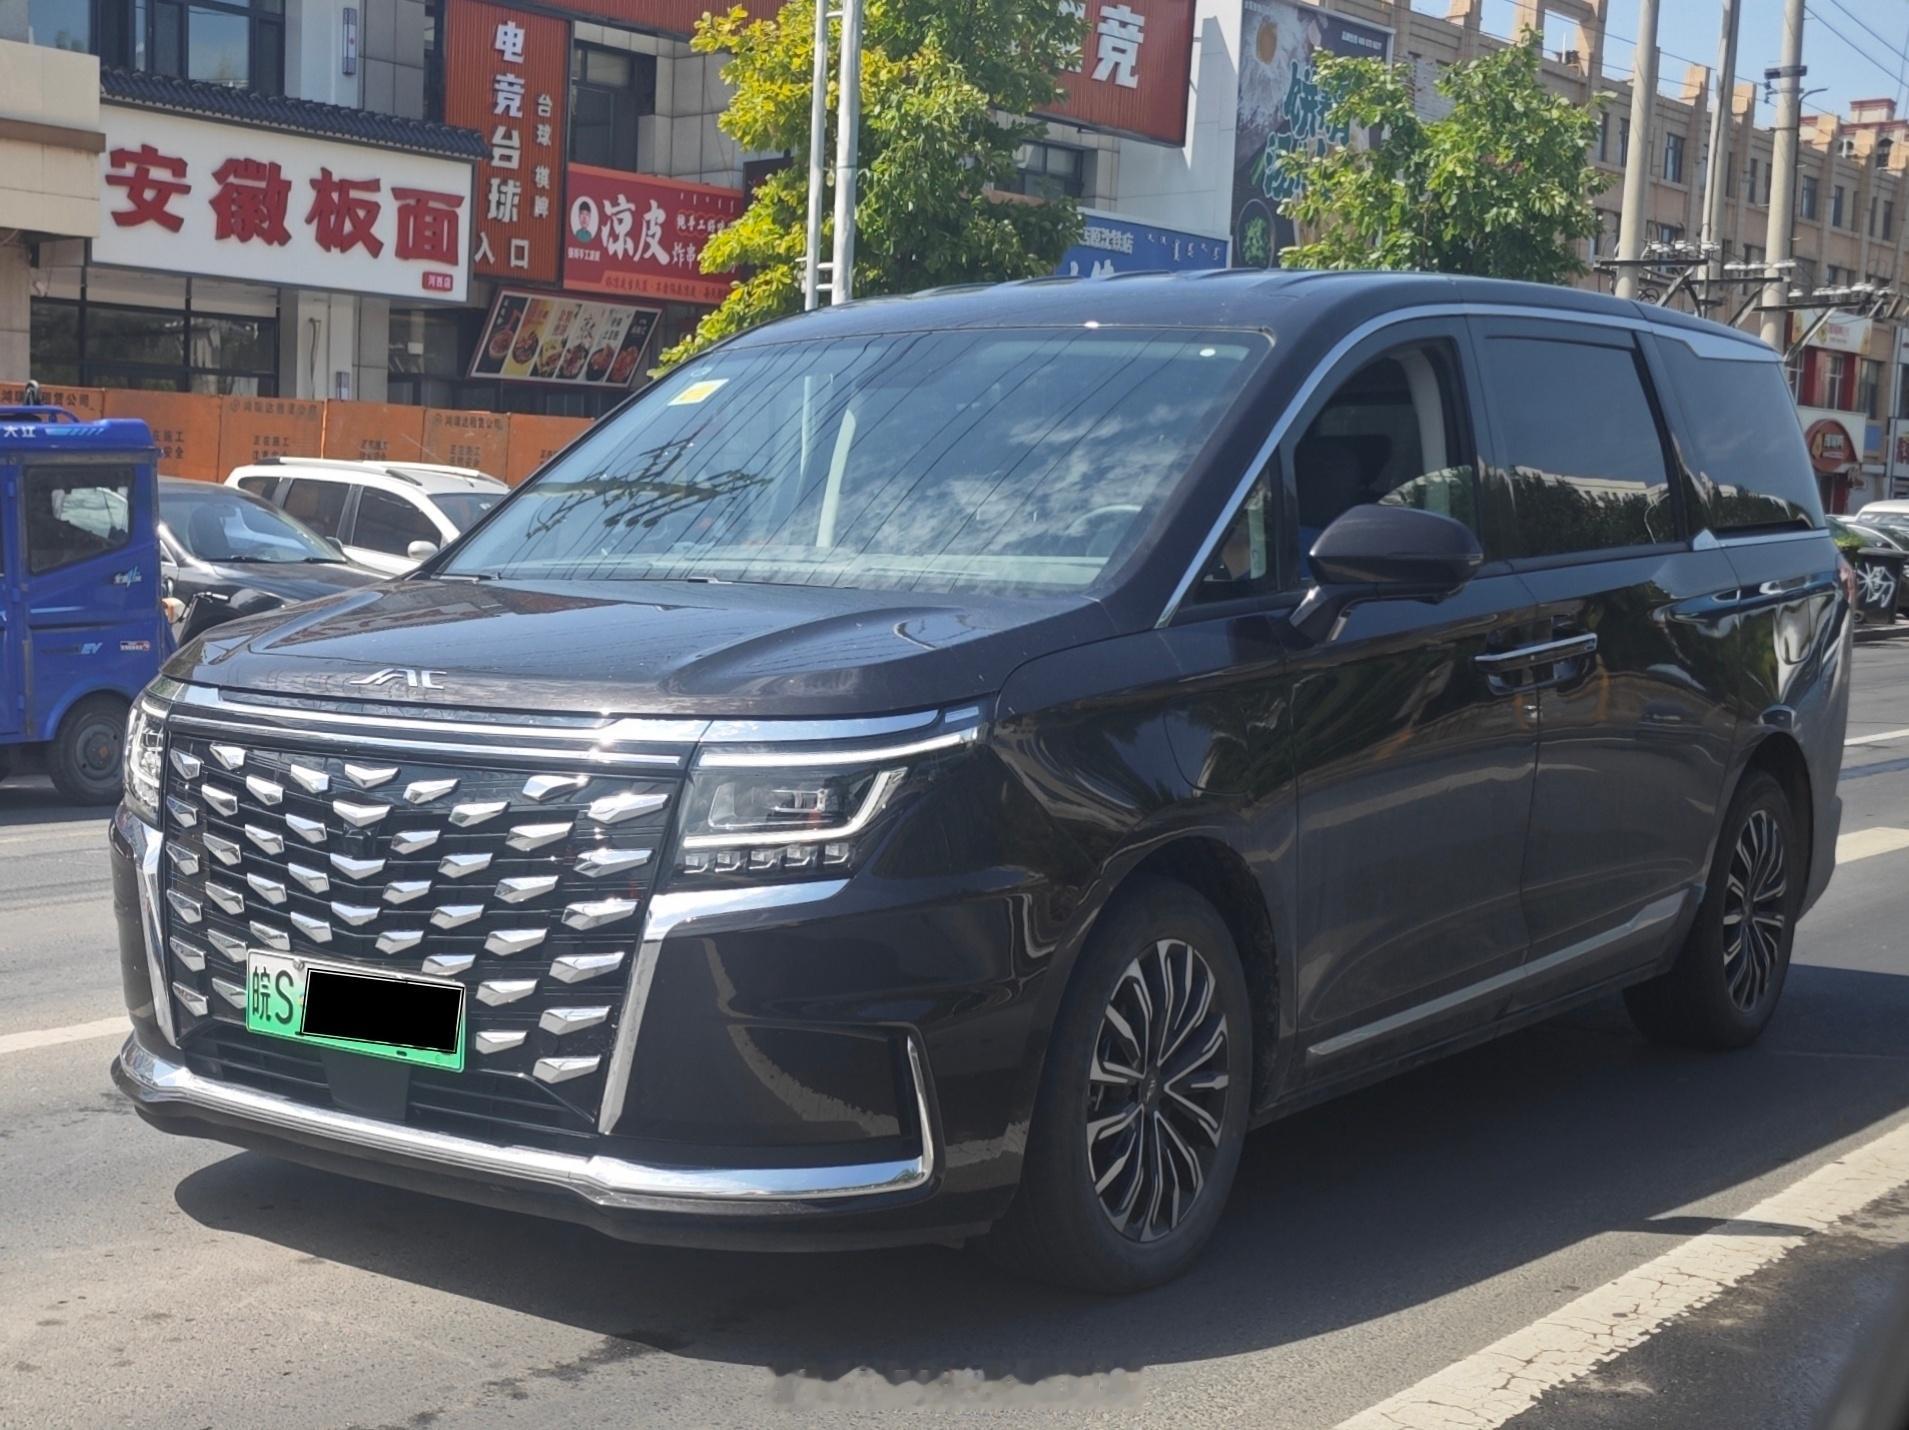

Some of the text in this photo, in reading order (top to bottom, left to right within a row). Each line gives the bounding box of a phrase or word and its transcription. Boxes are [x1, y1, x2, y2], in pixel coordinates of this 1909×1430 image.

[487, 20, 525, 224] 电竞台球
[536, 94, 553, 147] 台球
[104, 143, 466, 267] 安徽板面
[600, 193, 671, 267] 凉皮
[473, 231, 530, 270] 入口
[152, 429, 185, 444] 在施工
